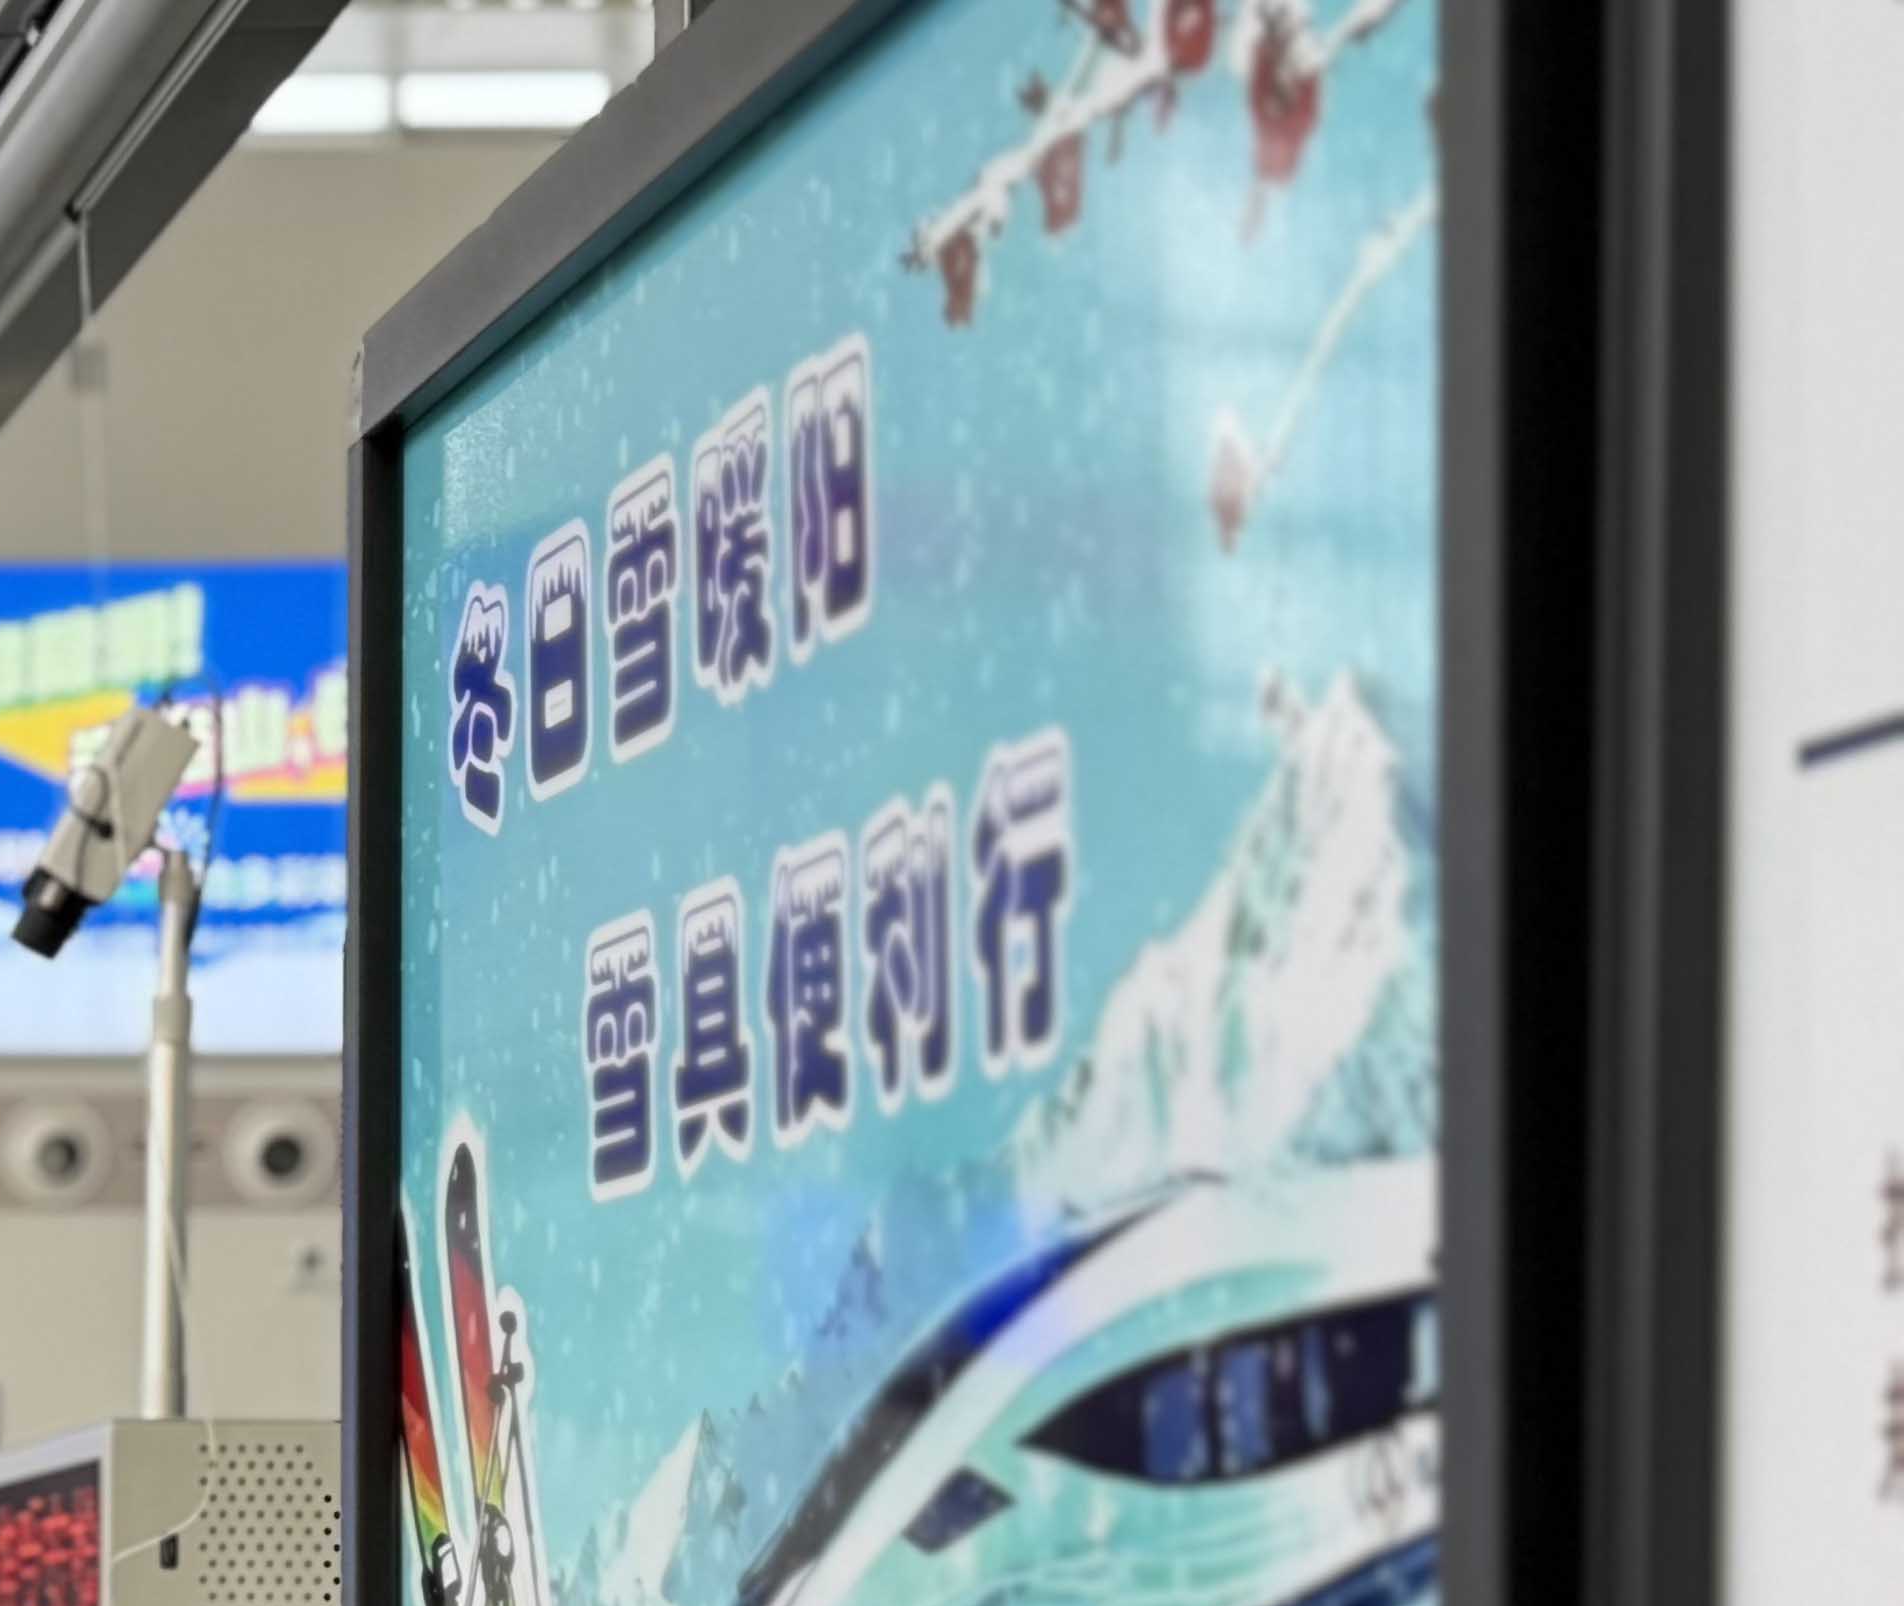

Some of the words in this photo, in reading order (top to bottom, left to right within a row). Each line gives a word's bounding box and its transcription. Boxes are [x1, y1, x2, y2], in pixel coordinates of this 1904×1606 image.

[450, 335, 872, 836] 冬日雪暖阳
[586, 727, 1071, 1203] 雪具便利行
